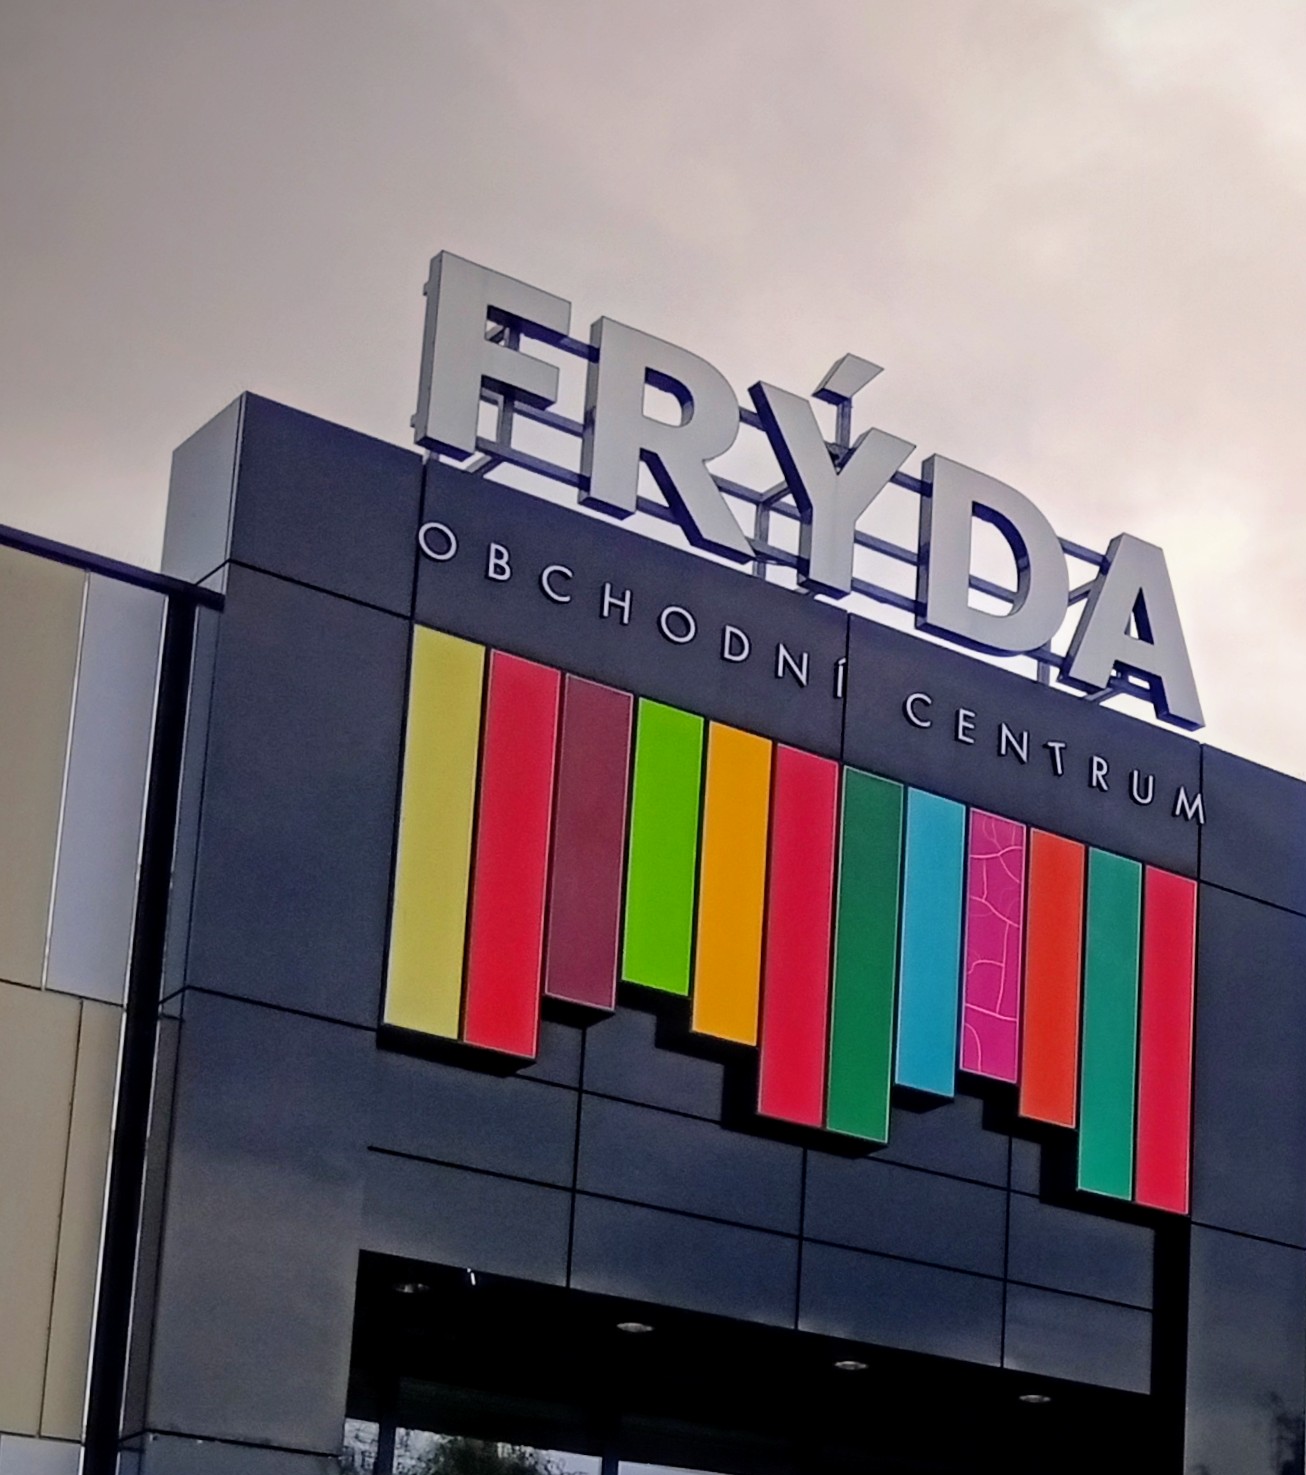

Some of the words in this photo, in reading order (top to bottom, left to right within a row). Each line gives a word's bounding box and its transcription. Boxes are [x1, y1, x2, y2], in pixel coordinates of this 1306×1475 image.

[414, 250, 1206, 731] FRÝDA
[417, 521, 848, 699] OBCHODNÍ
[903, 692, 1207, 826] CENTRUM
